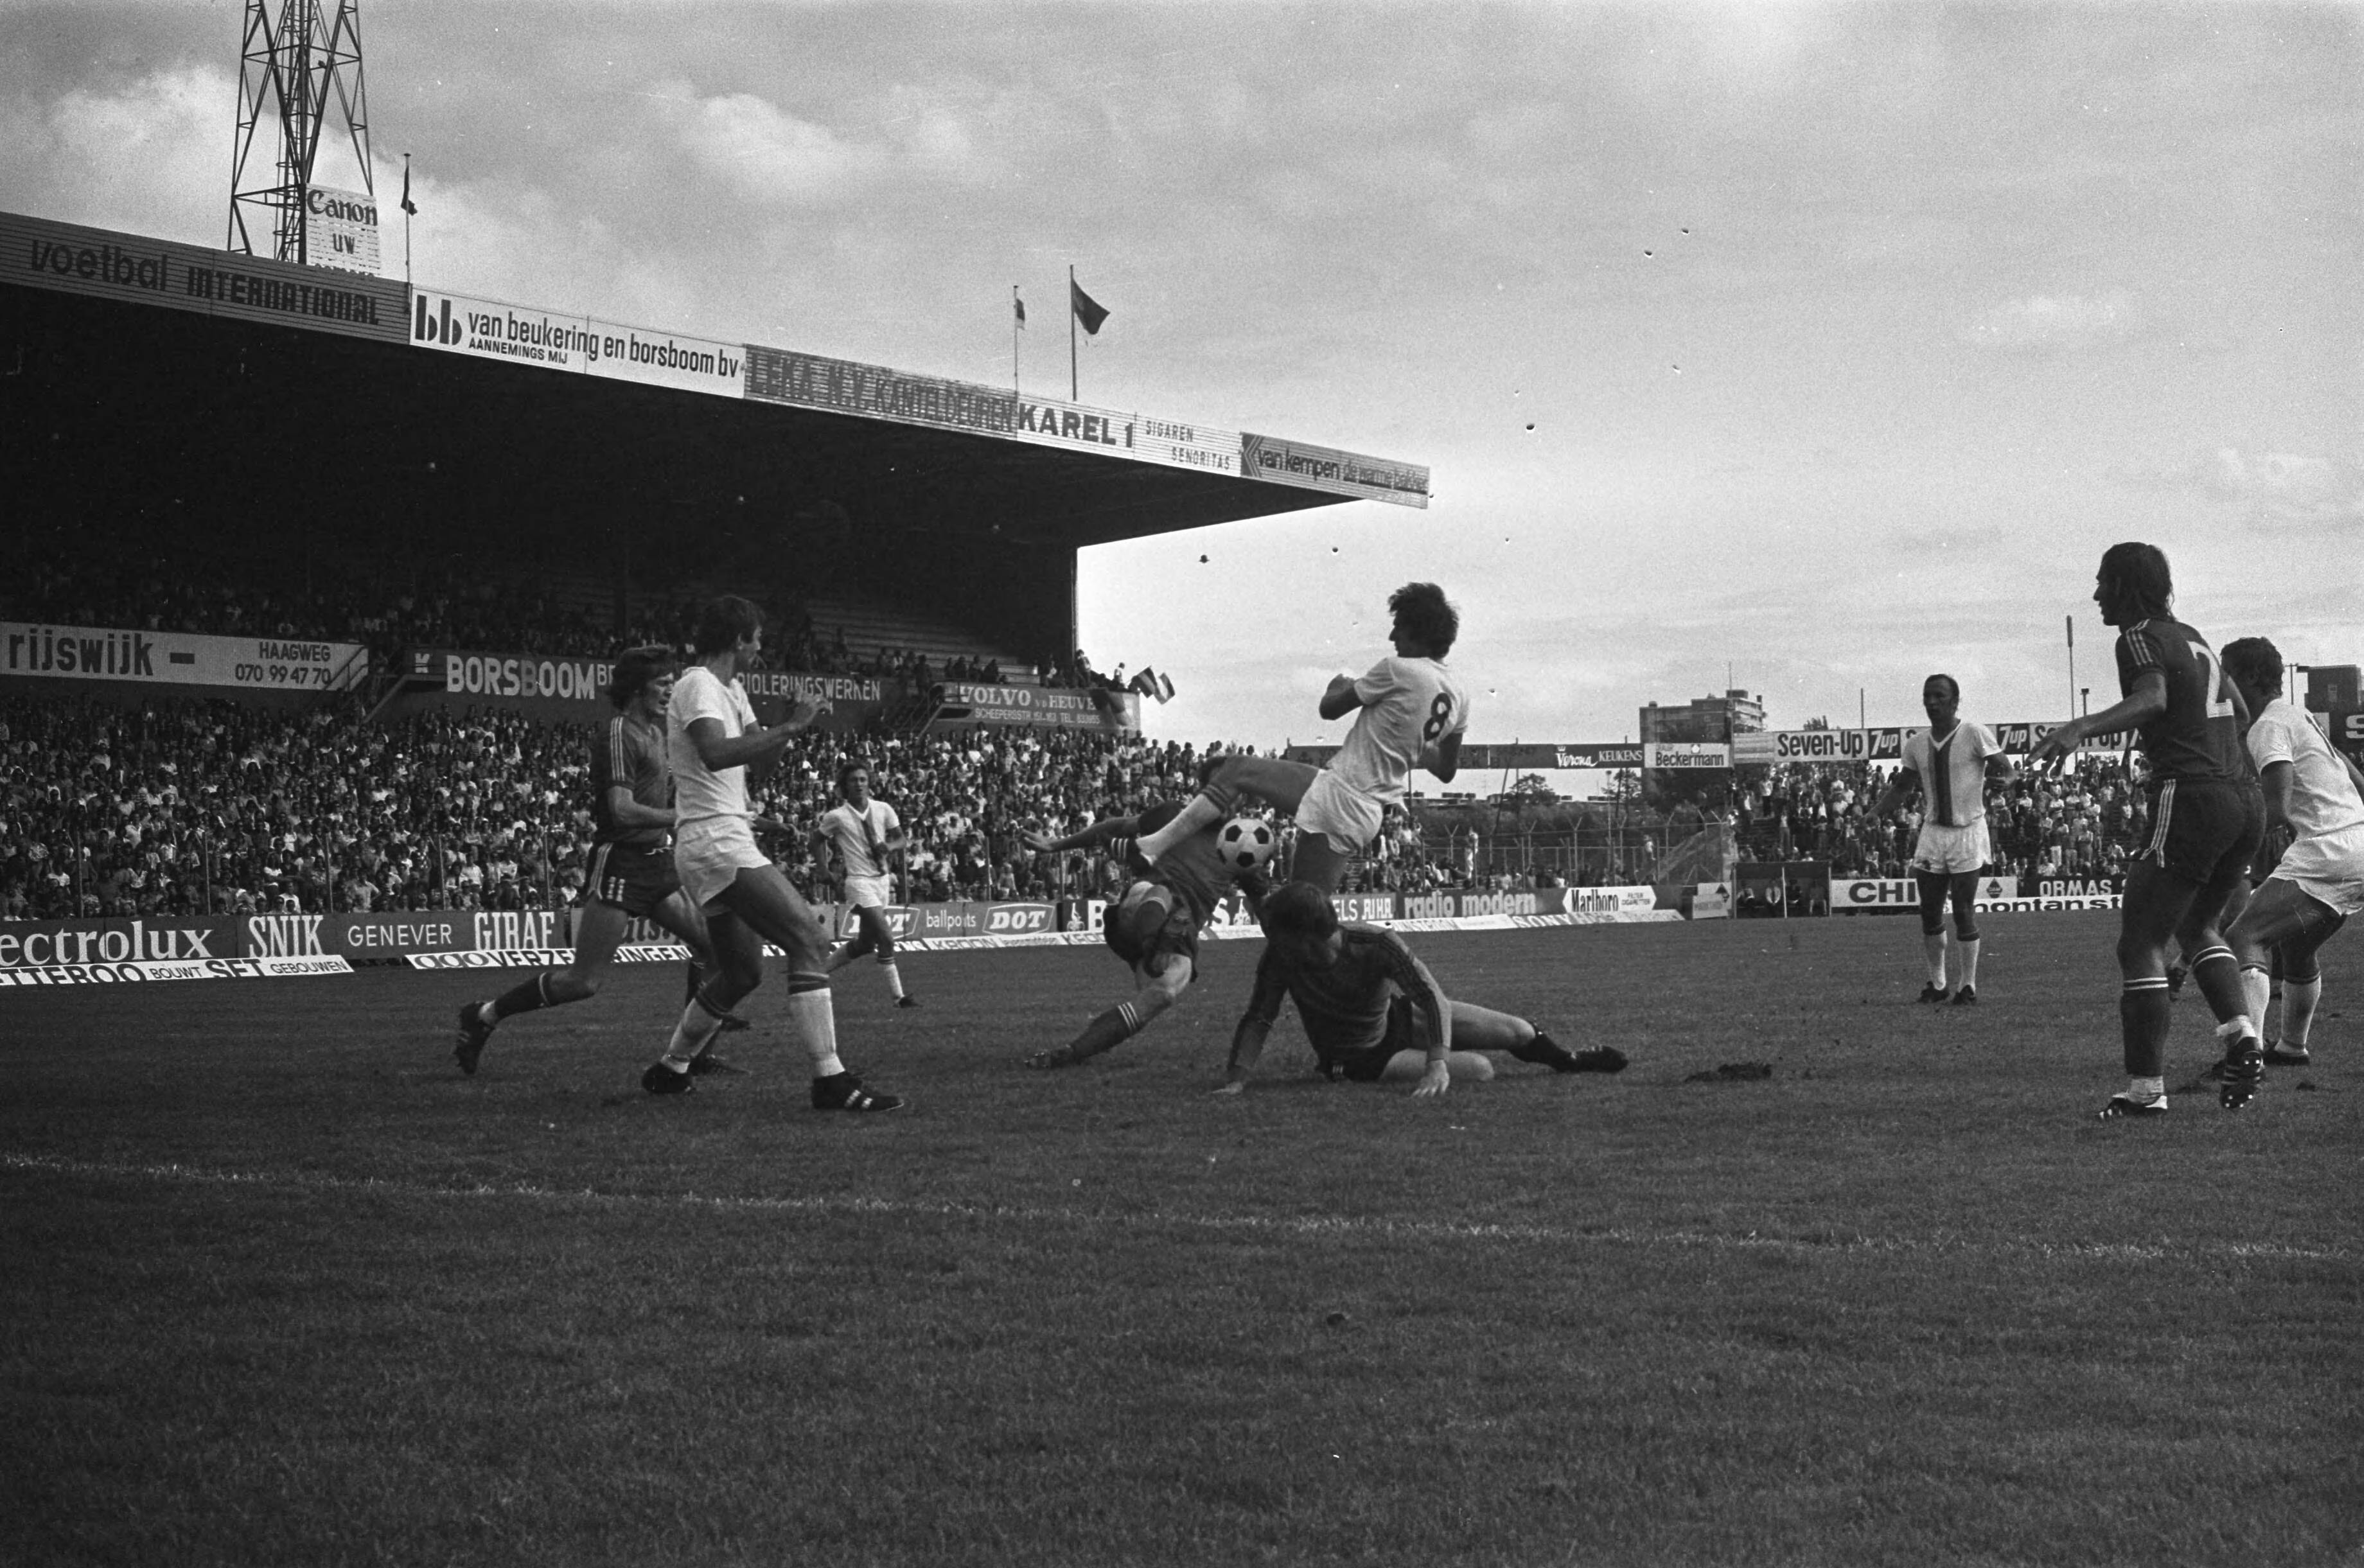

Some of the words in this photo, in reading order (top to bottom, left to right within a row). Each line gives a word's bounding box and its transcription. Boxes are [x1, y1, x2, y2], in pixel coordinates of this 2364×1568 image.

[307, 189, 378, 226] Canon
[31, 240, 167, 291] voetbal
[188, 265, 380, 326] INTERNATIONAL
[468, 312, 502, 338] van
[508, 311, 599, 361] beukering
[604, 337, 626, 359] en
[630, 333, 714, 374] borsboom
[718, 349, 739, 378] bv
[468, 337, 545, 361] AANNEMINGS
[548, 349, 568, 365] MIJ
[1019, 403, 1116, 445] KAREL
[1125, 423, 1133, 448] 1
[1146, 421, 1193, 442] SIGAREN
[1258, 450, 1283, 468] van
[1285, 448, 1339, 480] kempen
[9, 629, 154, 676] rijswijk
[259, 642, 331, 662] HAAGWEG
[234, 663, 263, 682] 070
[269, 665, 288, 683] 99
[290, 667, 308, 684] 47
[312, 667, 331, 685] 70
[446, 655, 595, 699] BORSBOOM
[960, 686, 1031, 707] VOLVO
[1049, 695, 1097, 710] HEUVE
[1424, 692, 1452, 742] 8
[1599, 750, 1643, 762] KEUKENS
[1777, 730, 1863, 758] Seven-Up
[1655, 751, 1724, 766] Beckermann
[1571, 889, 1619, 912] Marlboro
[2039, 879, 2112, 896] ORMAS
[1404, 890, 1454, 919] radio
[1461, 889, 1537, 917] modern
[989, 911, 1046, 929] DOT
[1512, 914, 1571, 928] SONY
[0, 920, 215, 965] ectrolux
[248, 915, 323, 958] SNIK
[348, 924, 452, 947] GENEVER
[475, 912, 554, 950] GIRAF
[149, 967, 201, 980] BOUWT
[270, 961, 347, 974] GEBOUWEN
